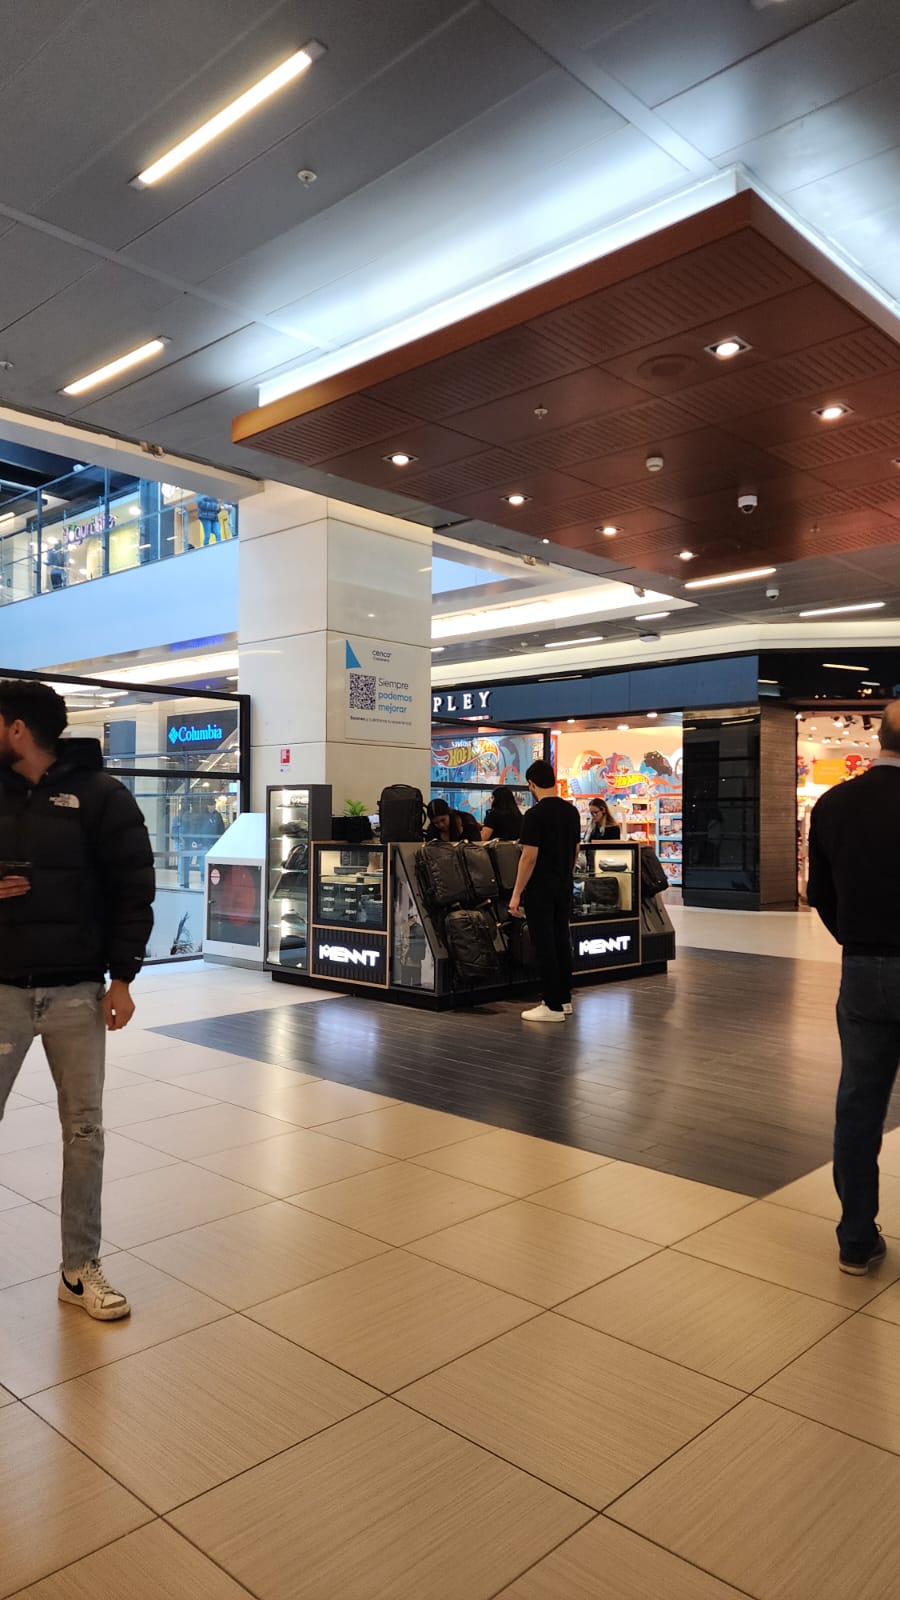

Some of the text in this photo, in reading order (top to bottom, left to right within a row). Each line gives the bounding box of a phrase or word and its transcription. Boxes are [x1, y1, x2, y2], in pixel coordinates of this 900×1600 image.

[378, 678, 409, 690] Siempre
[378, 692, 413, 702] podemos
[433, 691, 490, 713] PLEY
[378, 703, 407, 714] mejorar
[178, 724, 223, 742] Columbia
